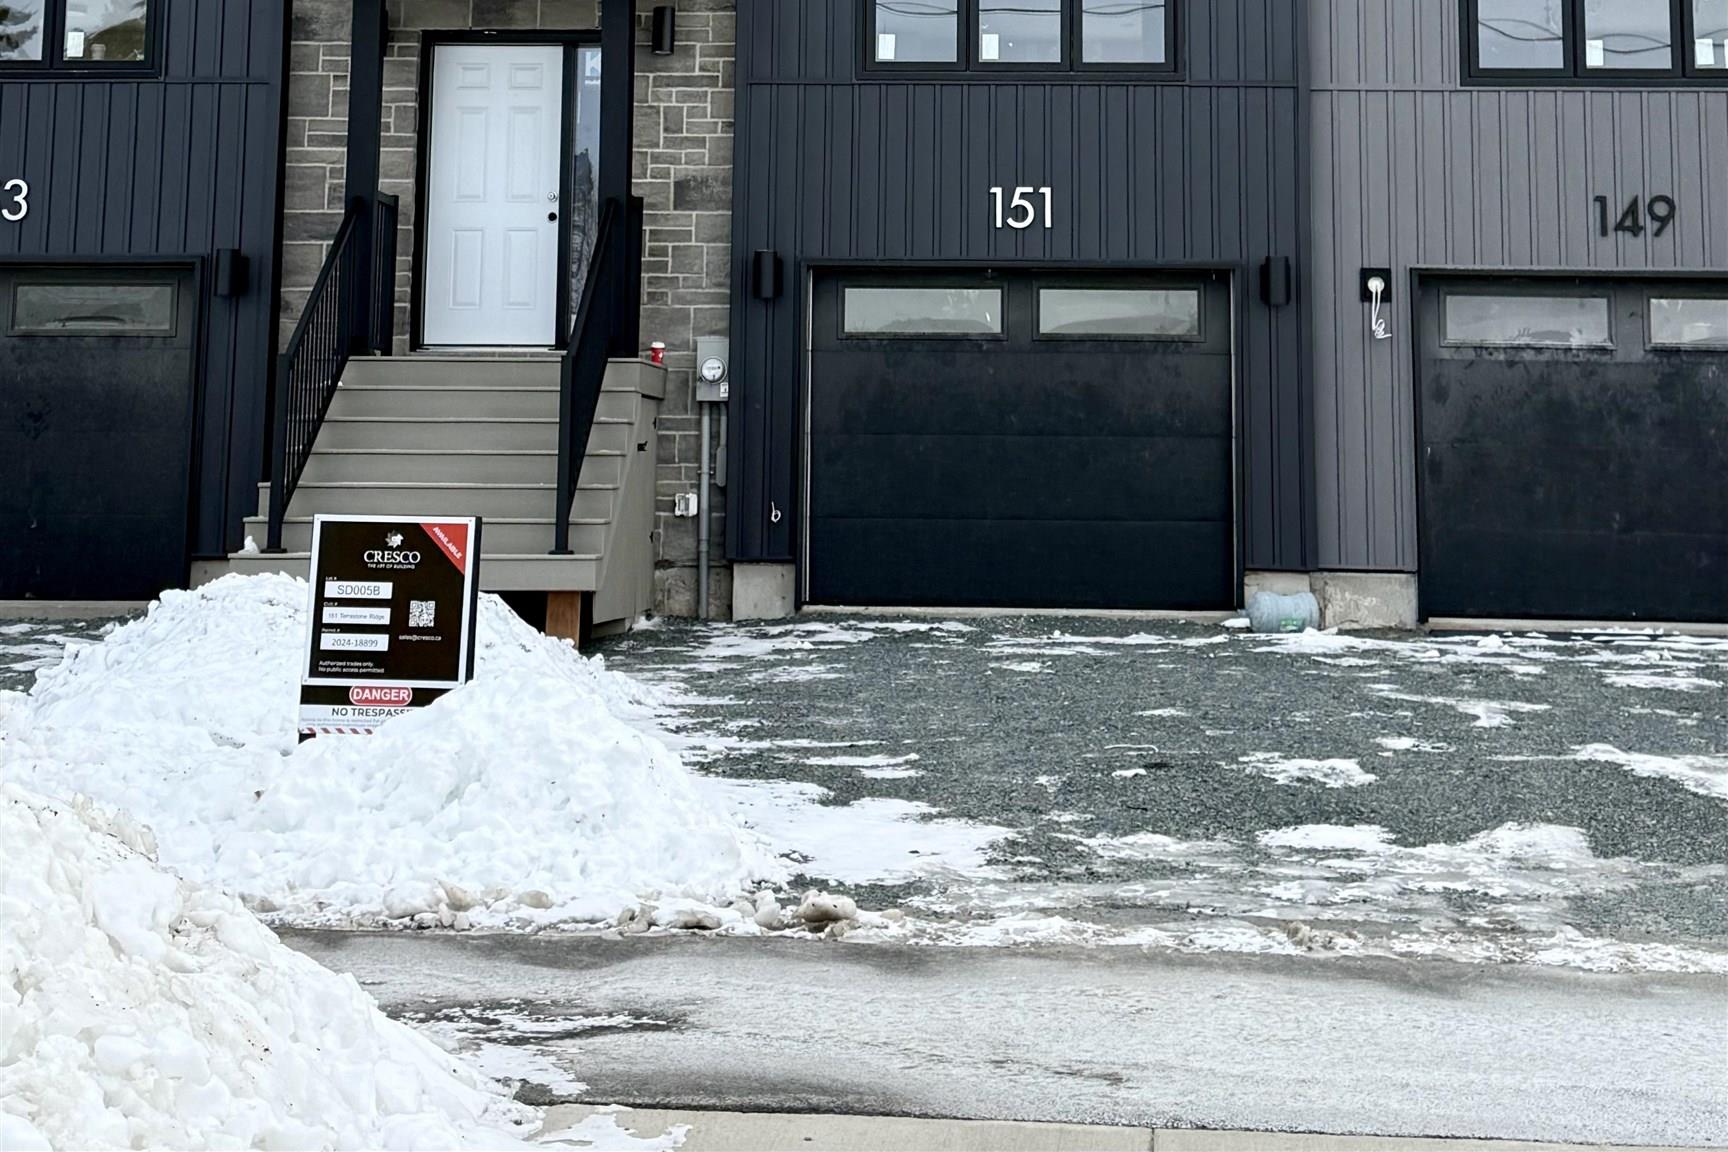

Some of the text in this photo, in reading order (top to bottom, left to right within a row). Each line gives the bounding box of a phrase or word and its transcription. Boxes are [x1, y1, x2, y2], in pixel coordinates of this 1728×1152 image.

[989, 186, 1052, 229] 151
[1593, 194, 1676, 238] 149
[432, 526, 462, 559] AVAILABLE
[363, 550, 421, 564] CRESCO
[337, 584, 381, 596] SD005B
[331, 638, 379, 648] 2024-18899
[352, 689, 409, 701] DANGER
[331, 708, 412, 717] NO TRESPASS
